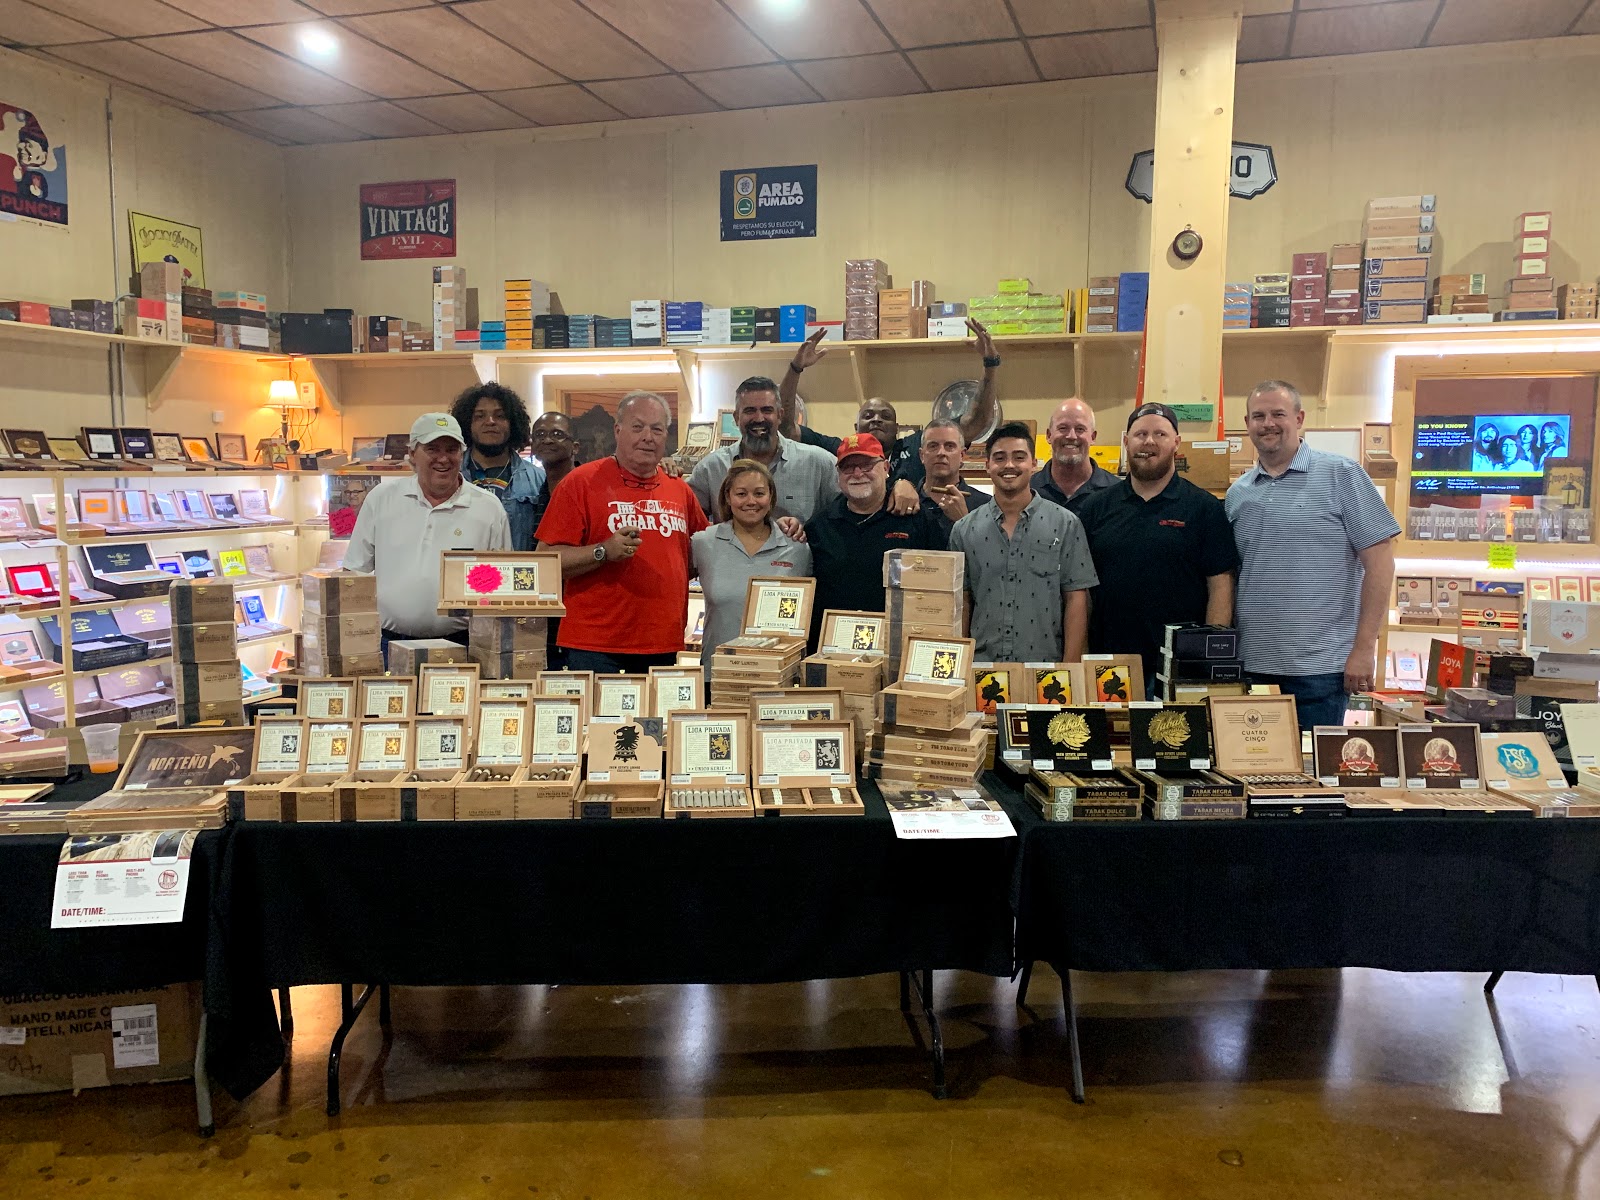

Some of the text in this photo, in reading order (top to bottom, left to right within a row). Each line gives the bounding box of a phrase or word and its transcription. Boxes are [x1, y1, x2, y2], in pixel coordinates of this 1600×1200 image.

[759, 182, 803, 197] AREA
[1, 195, 61, 220] PUNCH
[758, 196, 804, 207] FUMADO
[367, 201, 449, 237] VINTAGE
[733, 222, 767, 230] RESPETAMOS
[392, 236, 424, 246] EVIL
[608, 513, 658, 534] CIGAR
[1441, 656, 1461, 668] JOYA
[147, 753, 207, 771] NORTEÑO
[61, 907, 106, 917] DATE/TIME:
[10, 1013, 50, 1025] HAND
[55, 1008, 96, 1020] MADE
